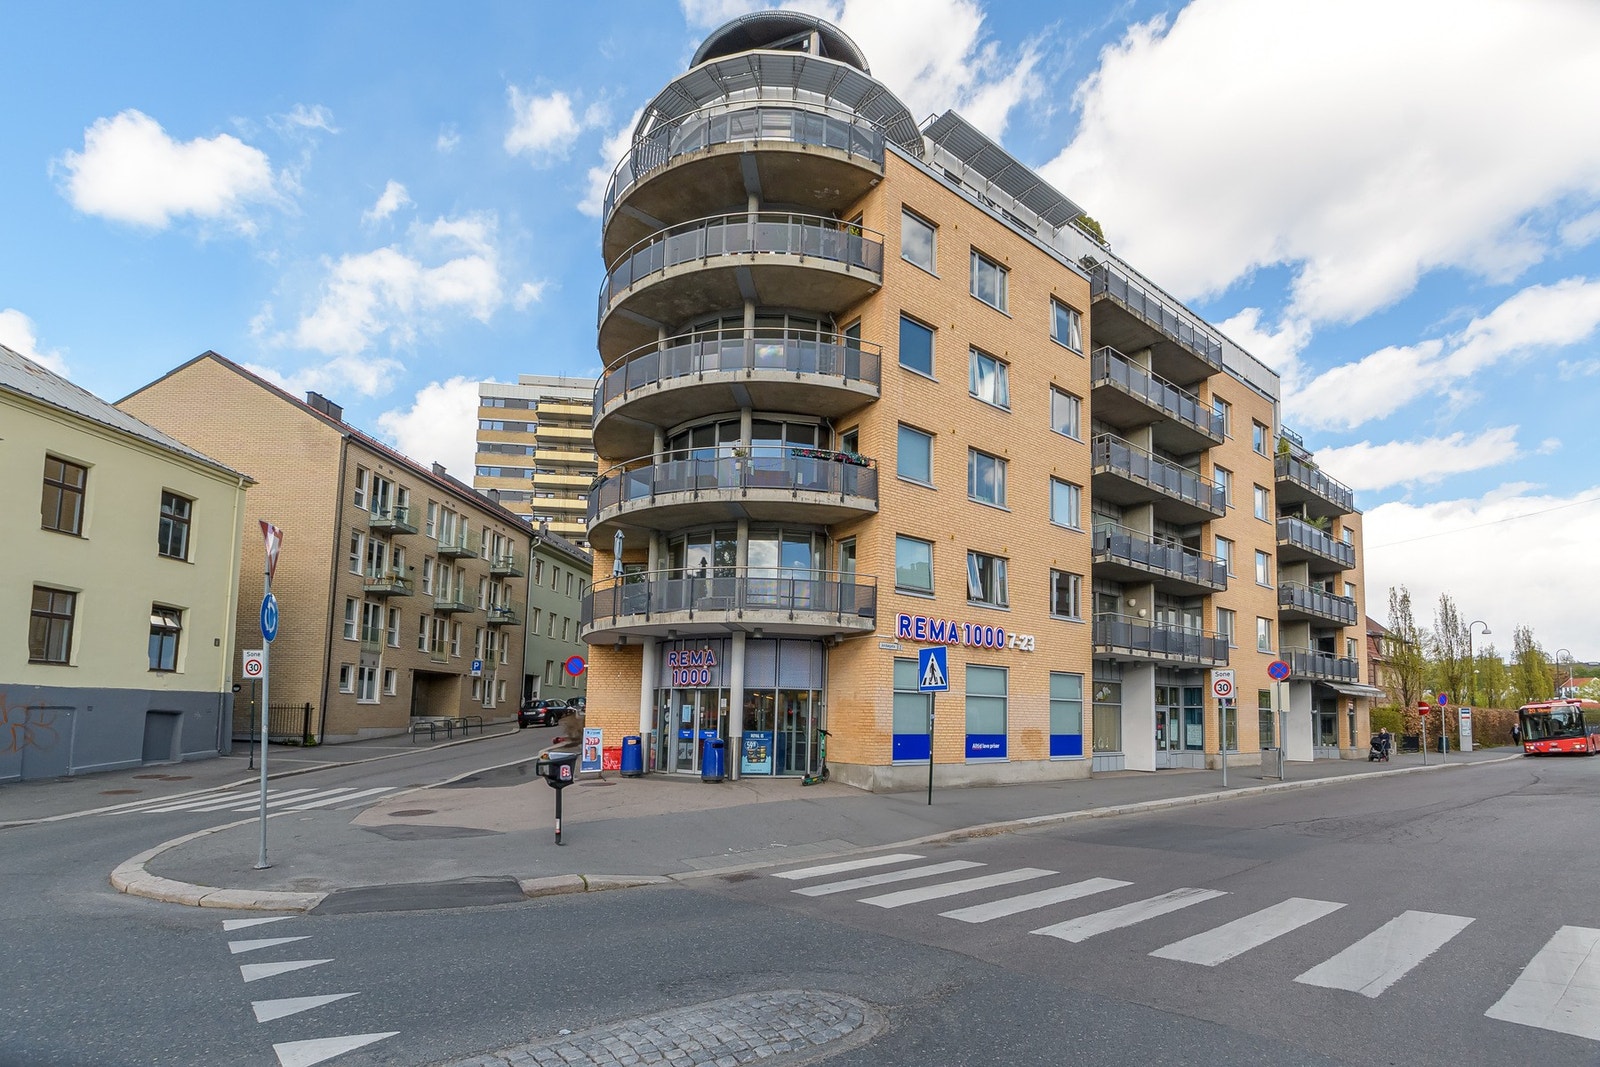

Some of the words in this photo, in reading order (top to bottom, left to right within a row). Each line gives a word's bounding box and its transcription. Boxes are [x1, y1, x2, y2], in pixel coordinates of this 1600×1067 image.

[895, 612, 960, 646] REMA
[962, 622, 1006, 650] 1000
[1008, 632, 1035, 652] 7-23
[667, 649, 716, 667] REMA
[248, 663, 259, 672] 30
[673, 668, 711, 686] 1000
[1217, 683, 1229, 692] 30
